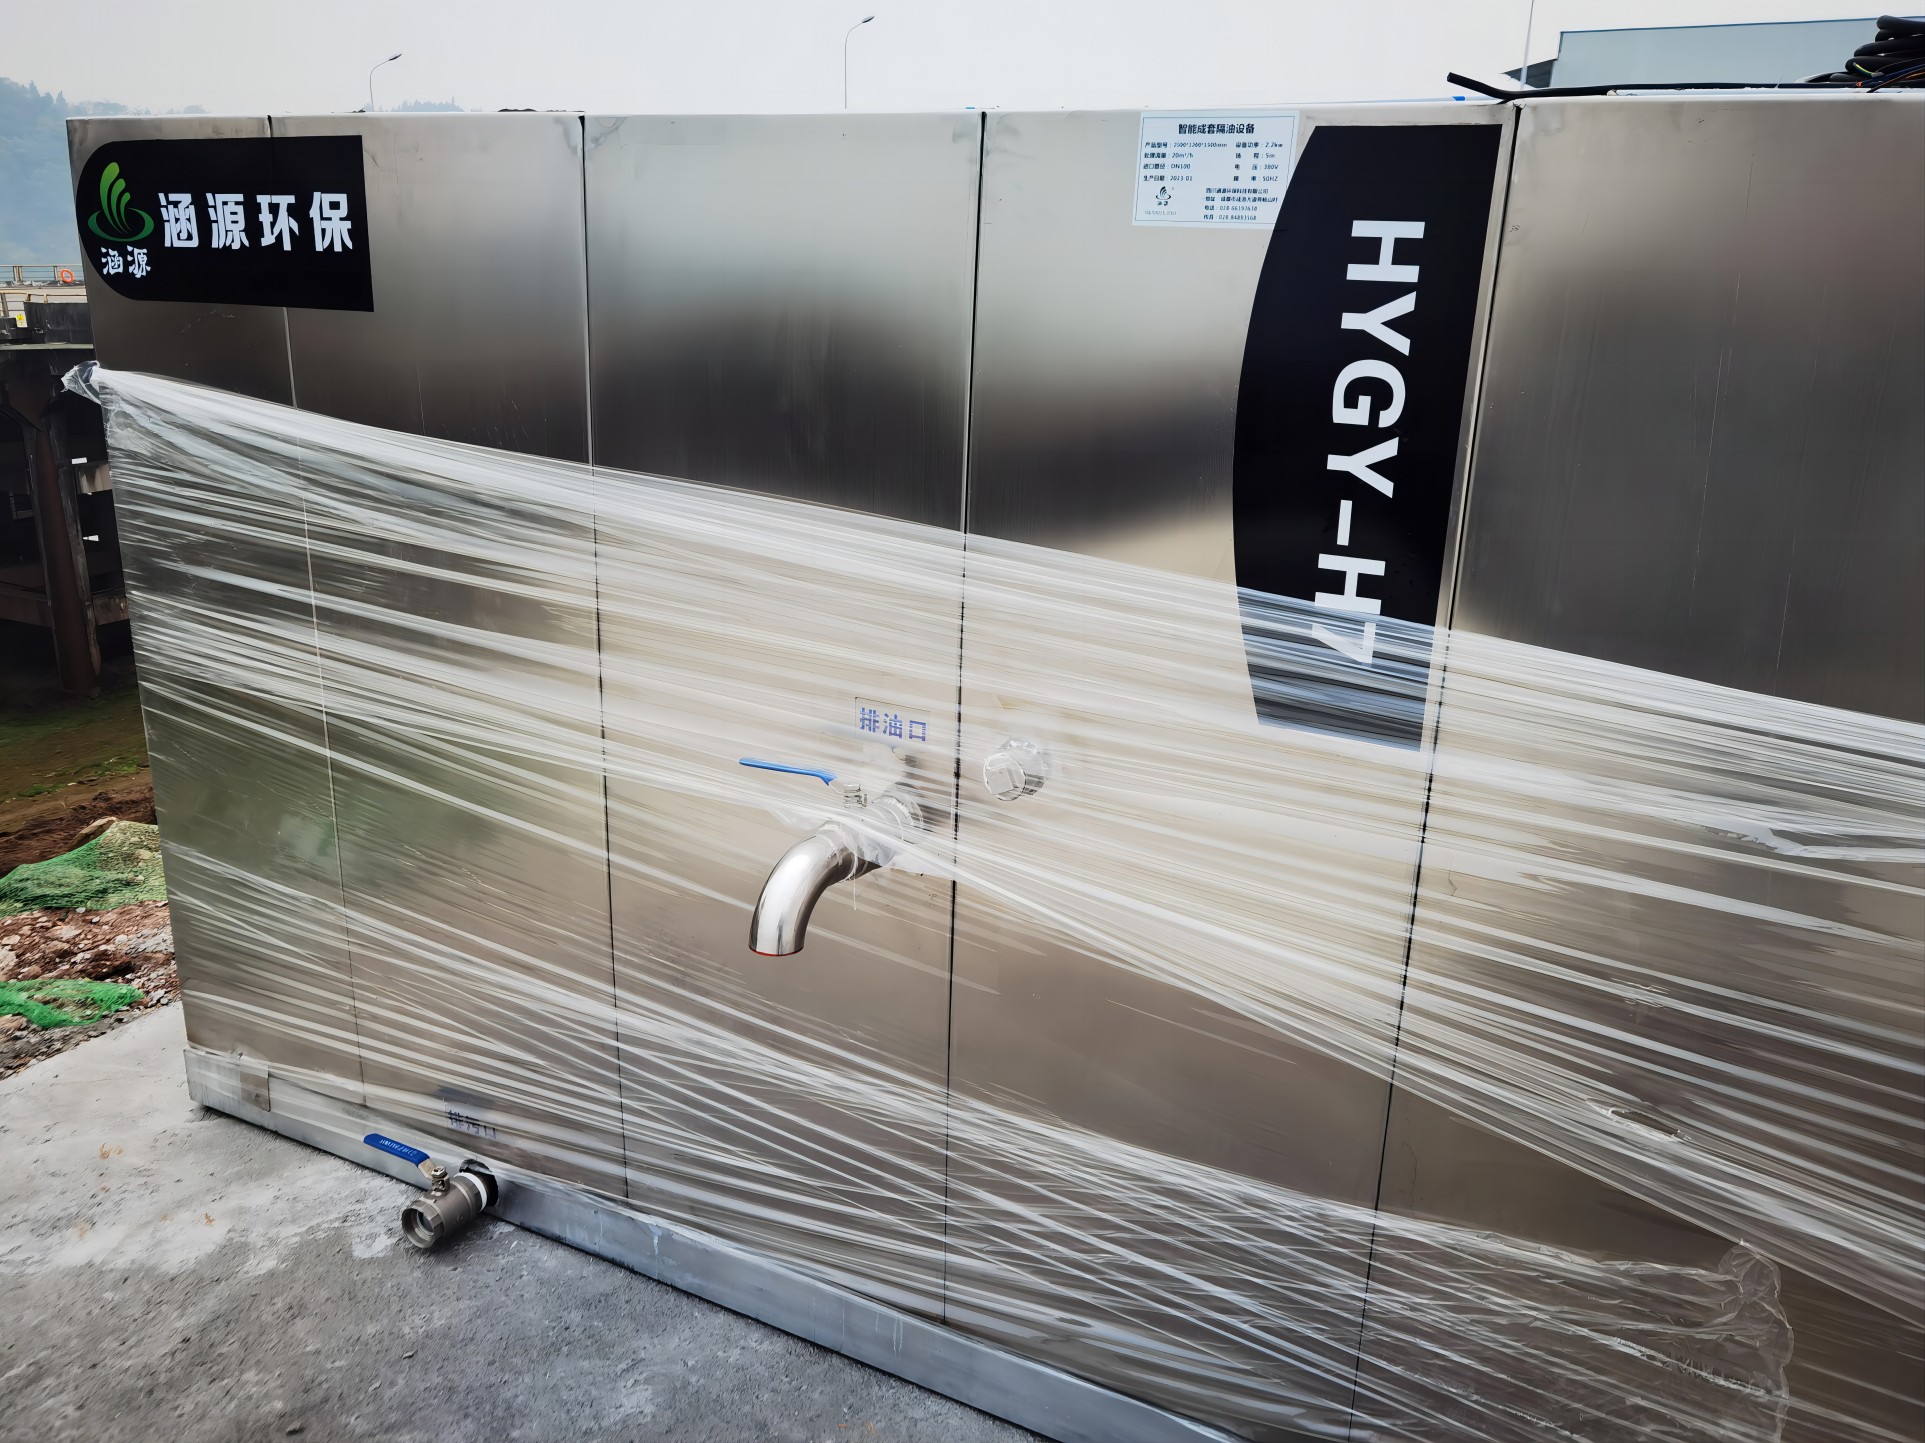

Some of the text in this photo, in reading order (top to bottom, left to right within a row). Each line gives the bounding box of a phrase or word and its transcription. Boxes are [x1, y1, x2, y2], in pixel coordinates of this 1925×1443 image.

[1178, 124, 1255, 134] 智能成套隔油设备
[158, 192, 353, 252] 涵源环保
[100, 245, 151, 278] 涵源
[860, 707, 927, 742] 排油口
